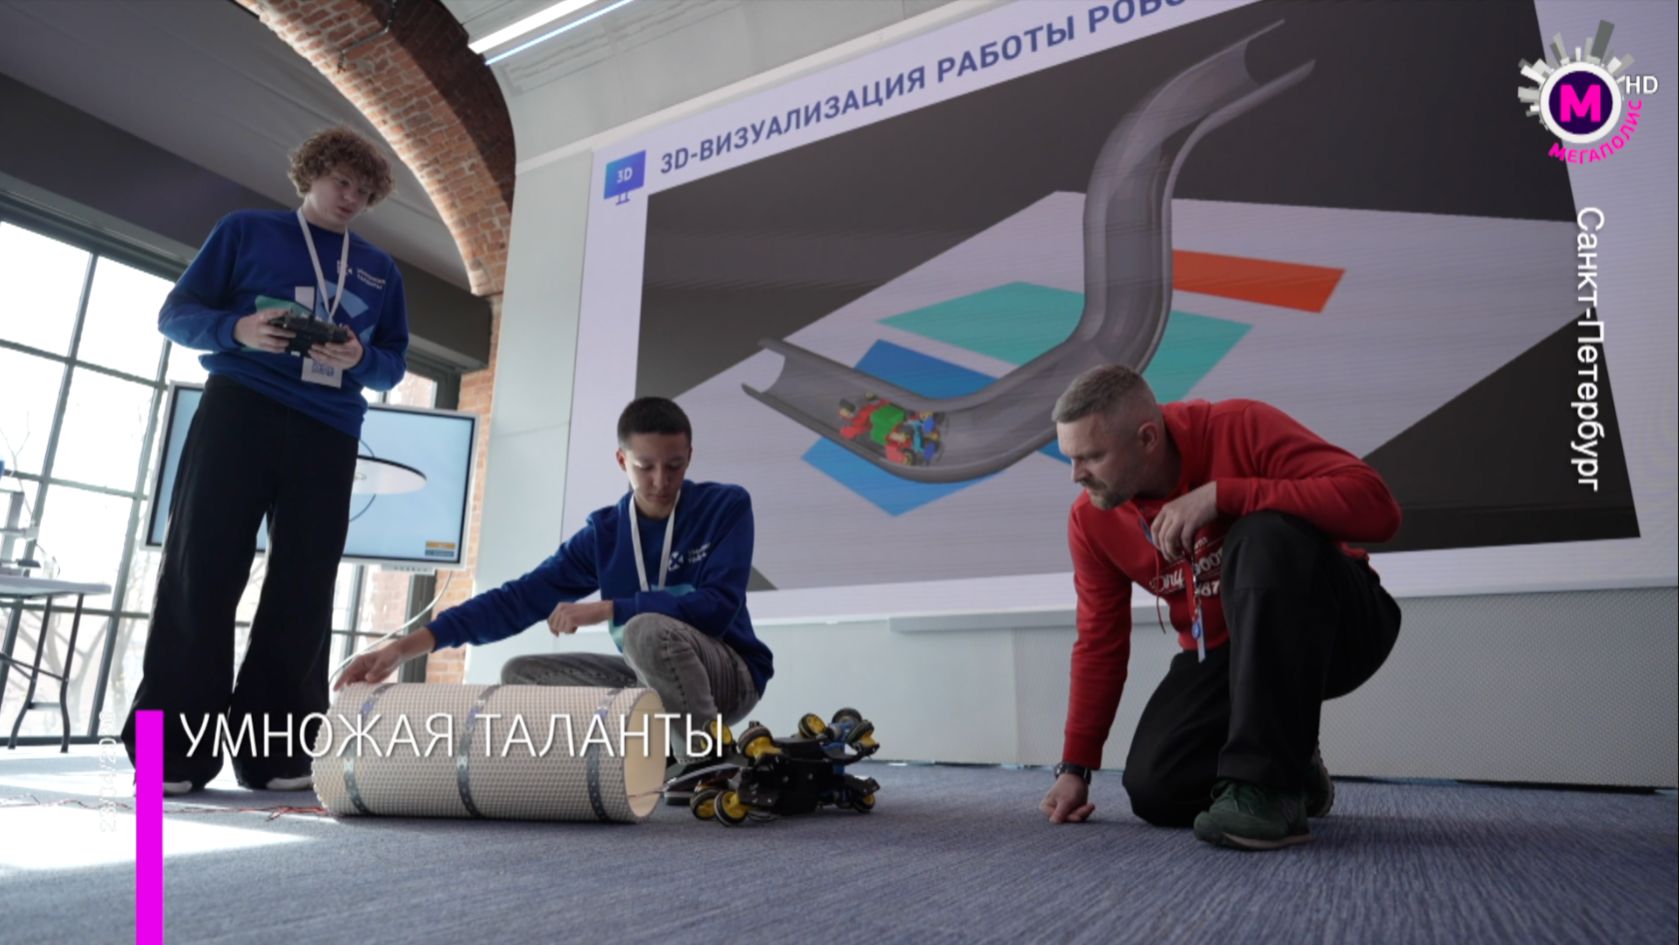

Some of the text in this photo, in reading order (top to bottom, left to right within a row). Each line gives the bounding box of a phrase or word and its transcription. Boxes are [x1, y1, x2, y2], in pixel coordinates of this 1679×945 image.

[660, 0, 1187, 175] 3D-ВИЗУАЛИЗАЦИЯ РАБОТЫ РОБ
[616, 166, 633, 184] 3D
